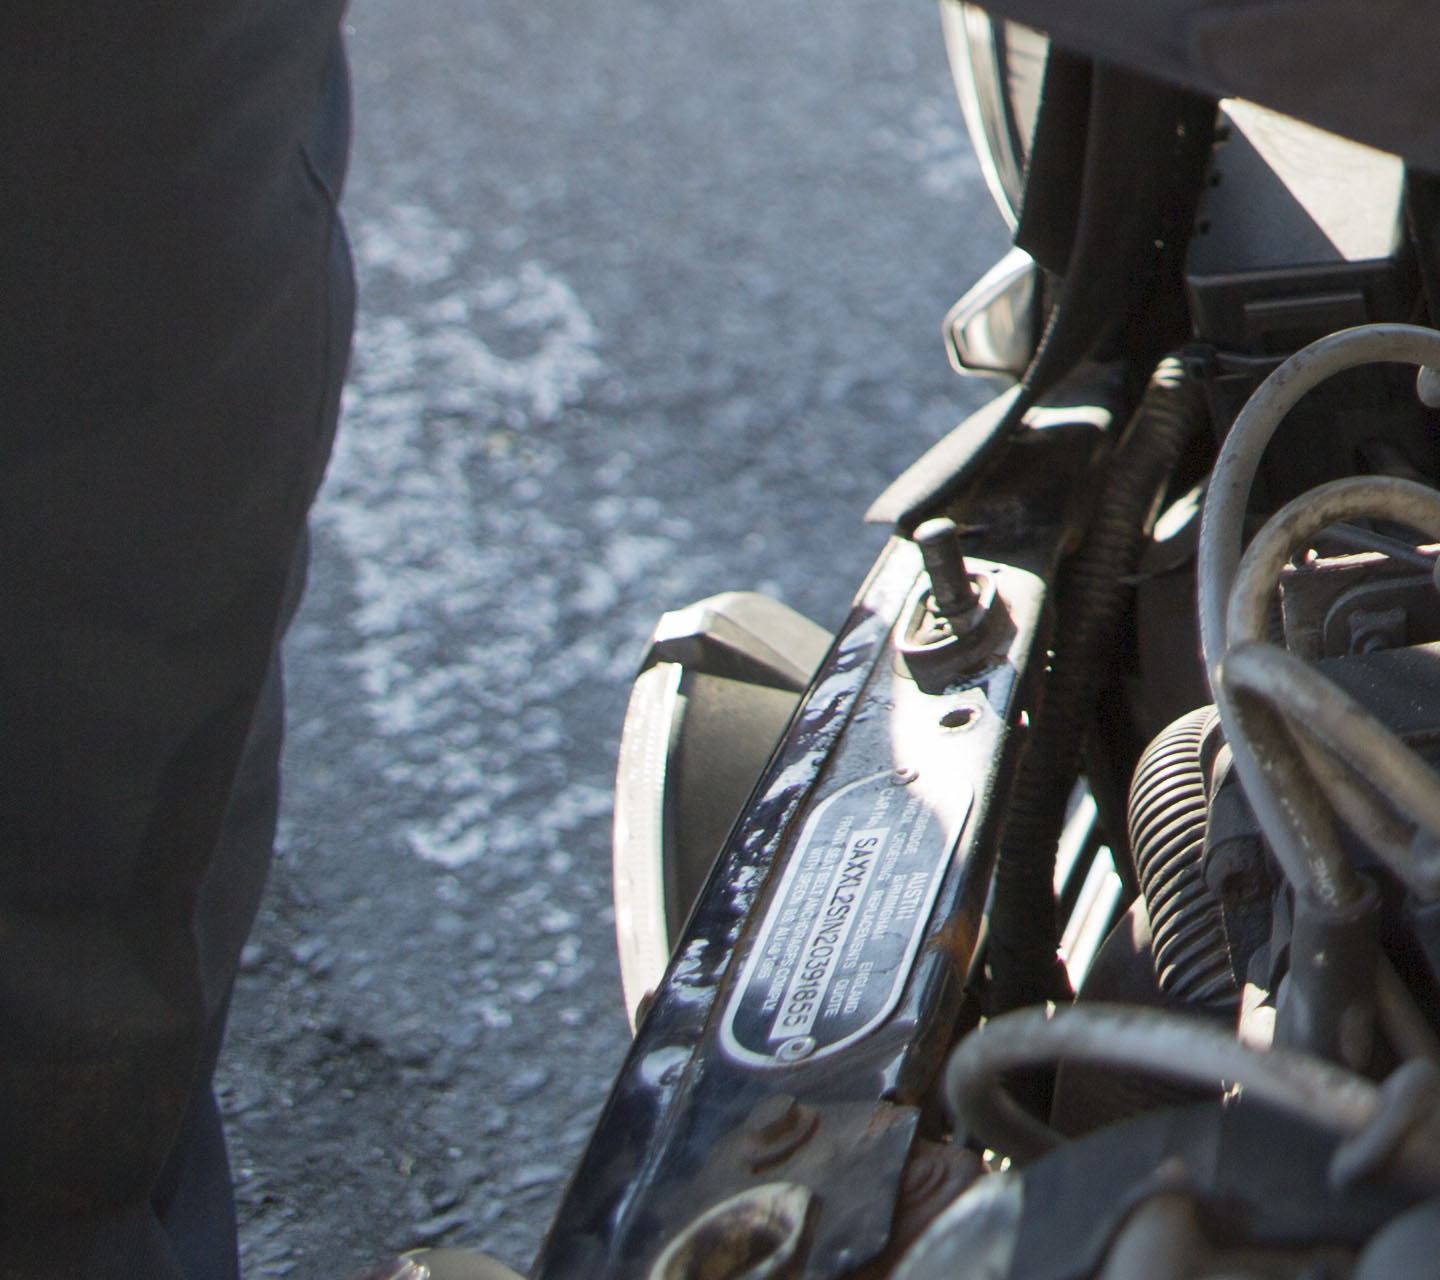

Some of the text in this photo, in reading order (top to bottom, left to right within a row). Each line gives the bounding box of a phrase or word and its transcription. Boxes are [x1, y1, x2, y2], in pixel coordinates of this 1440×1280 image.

[873, 786, 896, 808] CAR
[802, 847, 824, 871] WITH
[762, 816, 854, 1010] FRONT SEAT BELT ANCHORAGES COMPLY
[895, 872, 928, 919] AUSTIN
[842, 890, 884, 967] REPLACEMENTS
[823, 980, 849, 1017] QUOTE
[841, 962, 873, 1014] ENGLAND
